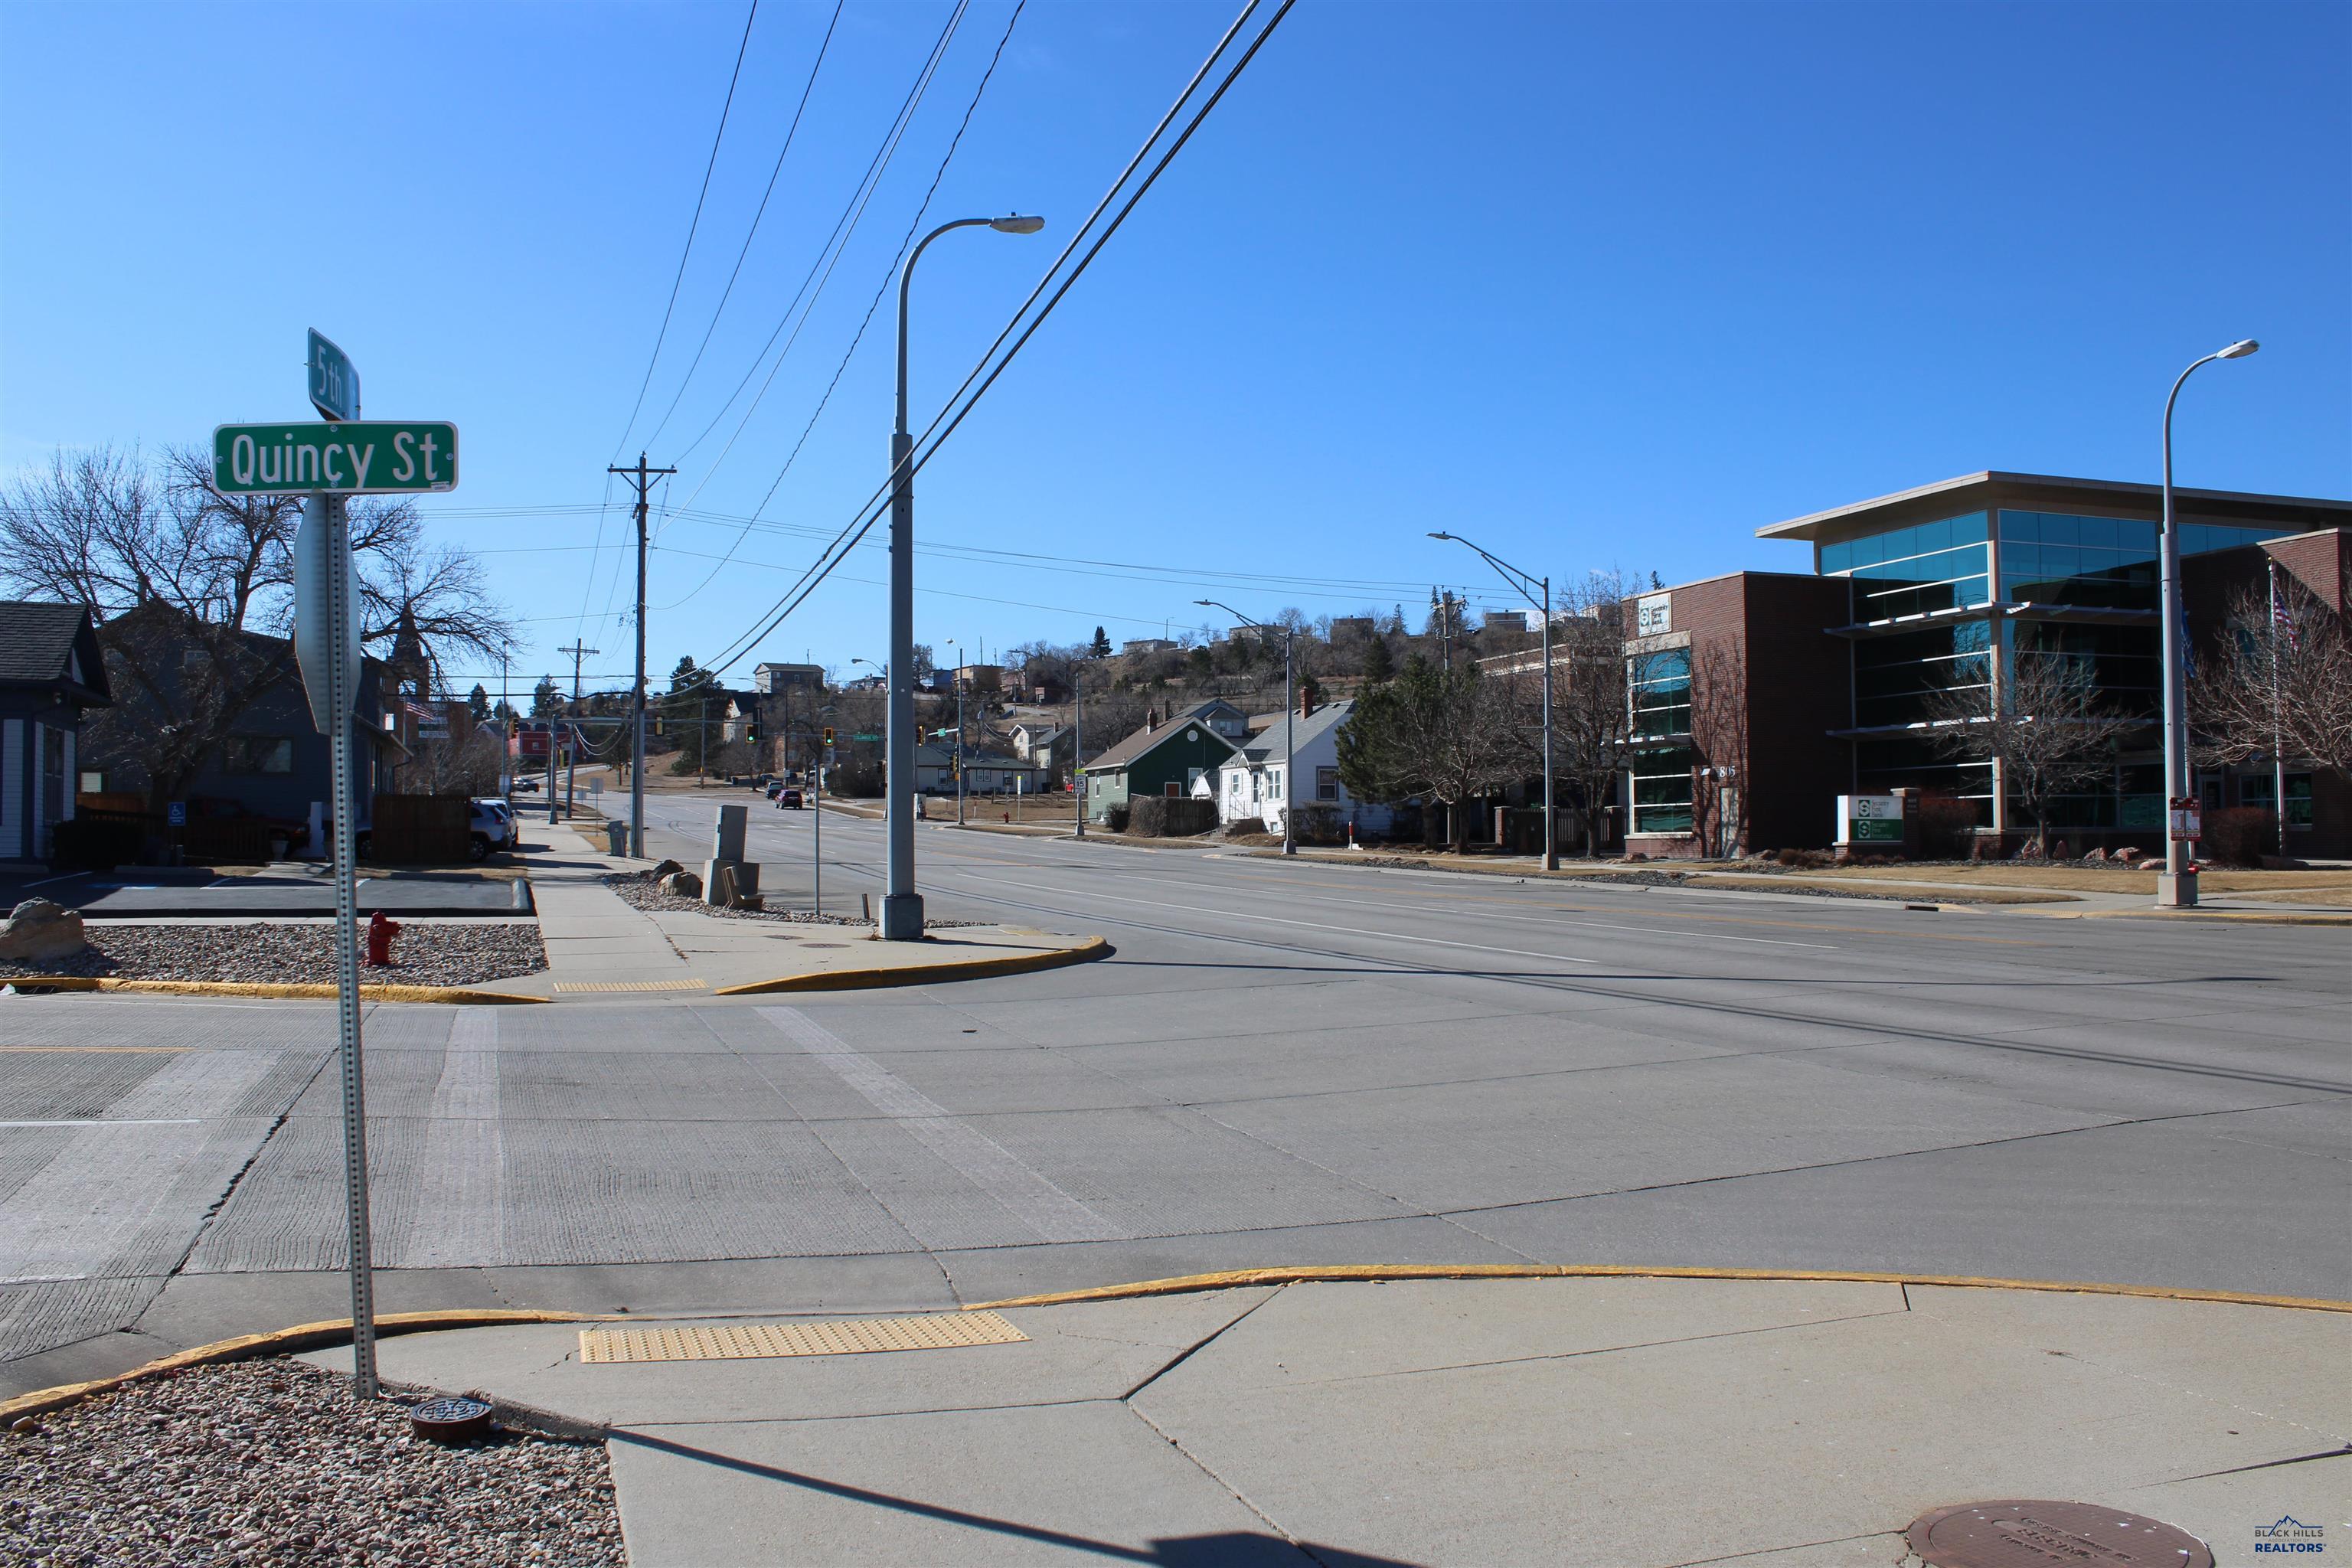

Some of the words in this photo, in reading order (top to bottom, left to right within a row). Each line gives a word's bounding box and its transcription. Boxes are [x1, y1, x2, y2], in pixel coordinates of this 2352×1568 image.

[318, 345, 342, 408] 5th
[233, 433, 375, 488] Quincy
[392, 431, 438, 482] St
[1720, 766, 1736, 778] 805
